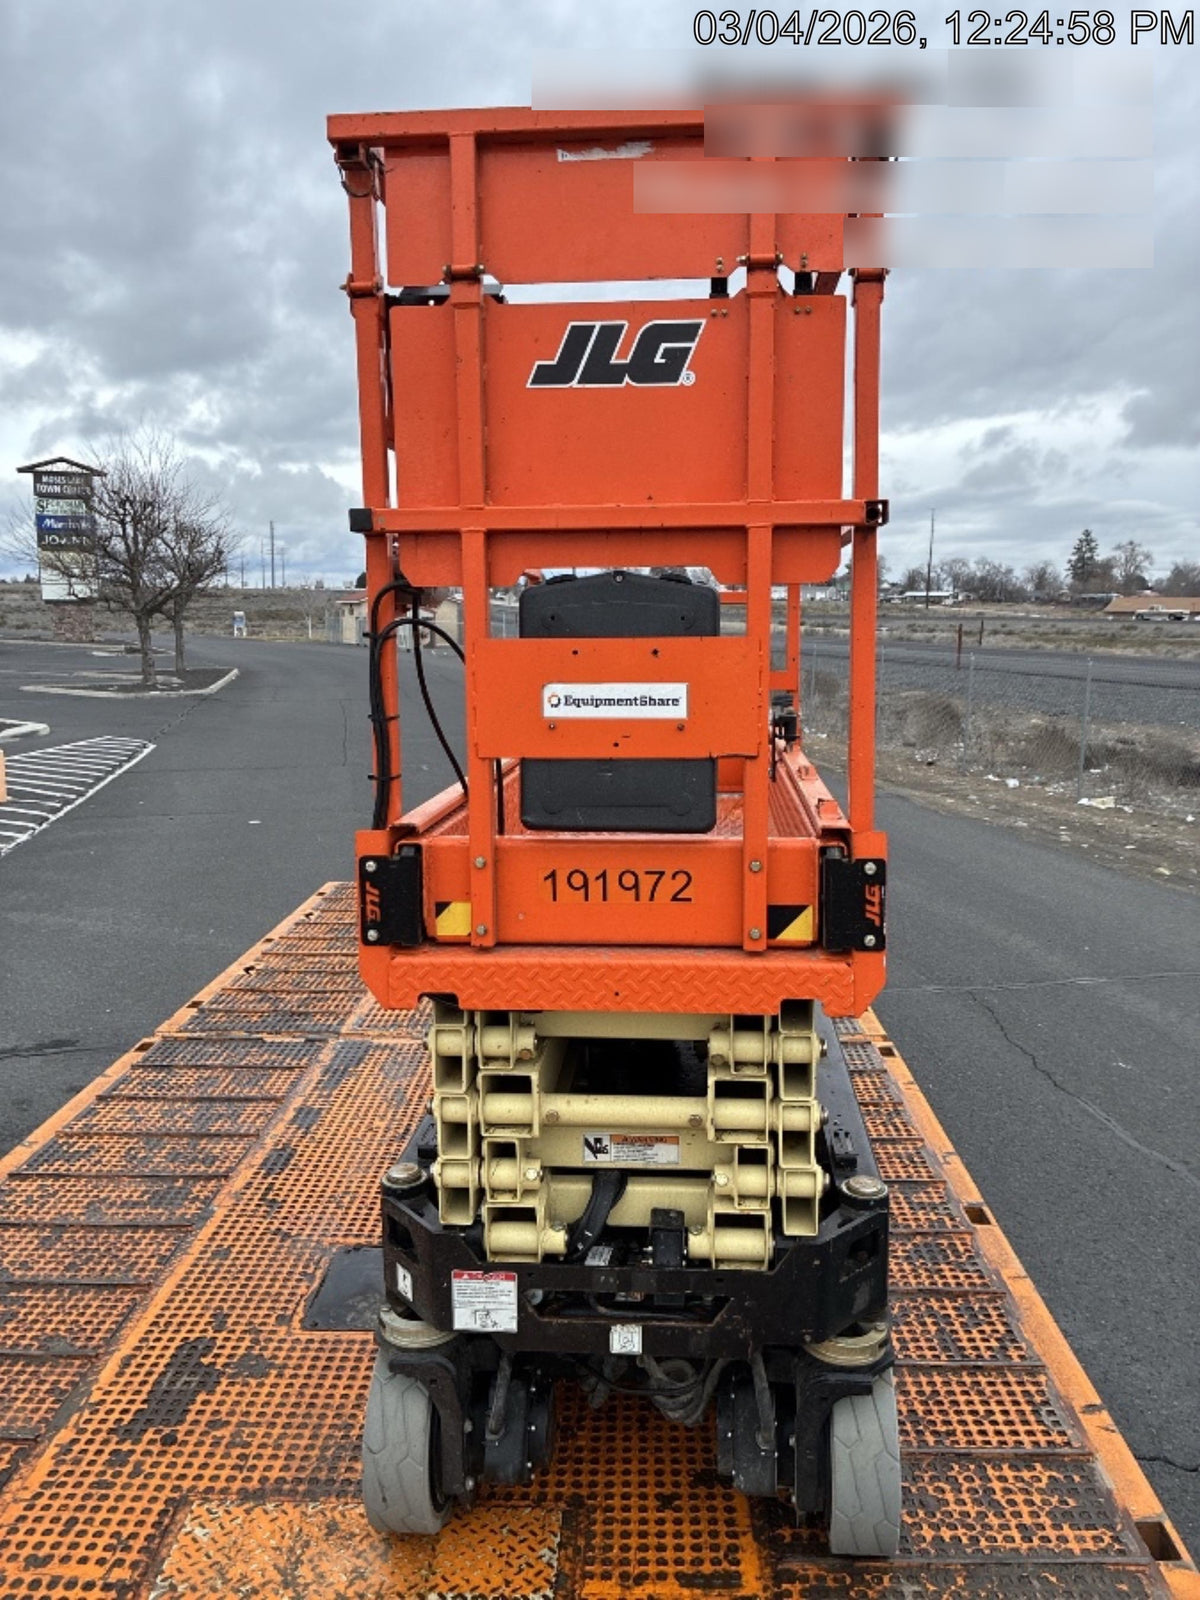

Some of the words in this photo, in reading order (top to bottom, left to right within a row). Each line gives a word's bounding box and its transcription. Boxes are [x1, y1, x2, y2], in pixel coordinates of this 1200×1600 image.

[526, 319, 707, 388] JLG
[36, 483, 61, 494] TOWN
[564, 694, 681, 708] EquipmentShare
[365, 881, 380, 922] JLG
[543, 868, 693, 902] 191972
[865, 884, 881, 927] JLG
